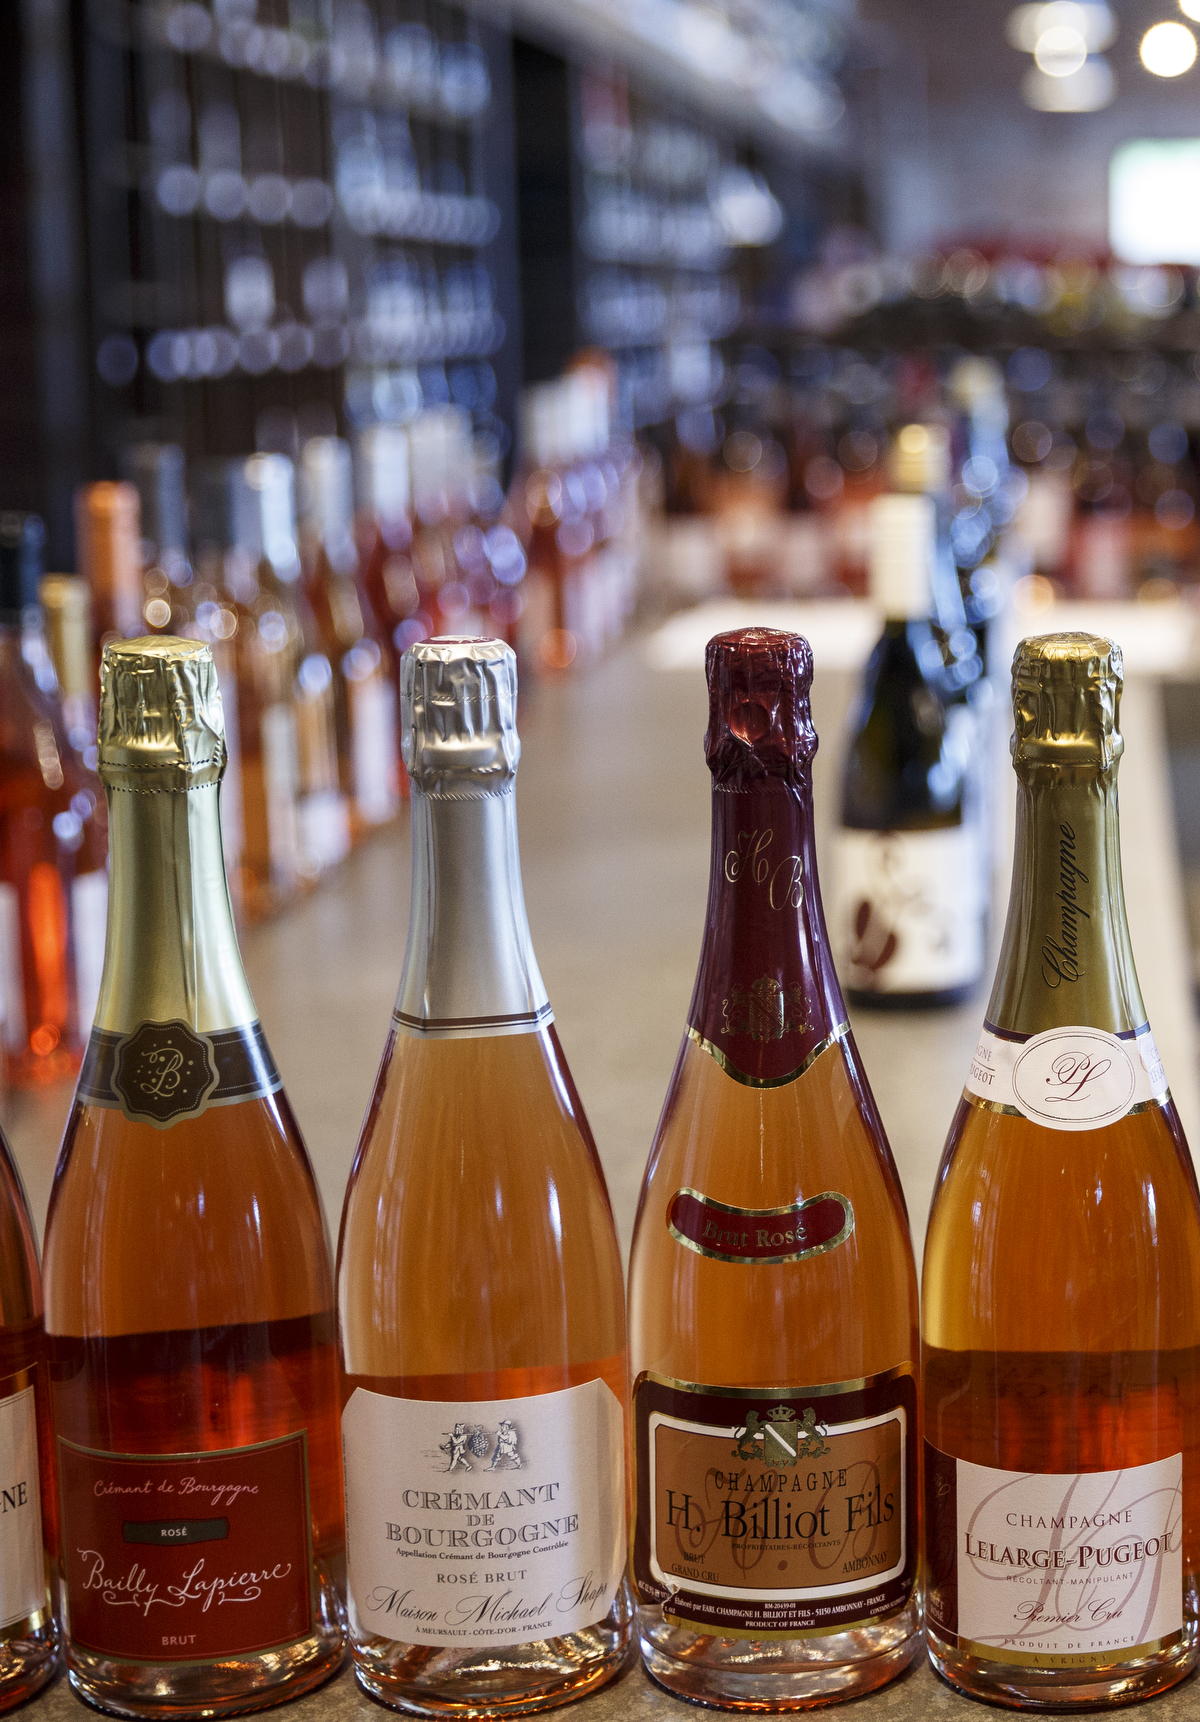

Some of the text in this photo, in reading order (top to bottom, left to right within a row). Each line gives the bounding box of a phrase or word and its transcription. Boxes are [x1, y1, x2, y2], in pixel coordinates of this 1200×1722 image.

[1041, 820, 1089, 989] Champagne
[703, 1220, 808, 1247] Brut Rosé
[94, 1477, 259, 1505] Crémant de Bourgogne
[714, 1468, 848, 1492] CHAMPAGNE
[401, 1482, 560, 1511] CRÉMANT
[466, 1514, 494, 1527] DE
[666, 1489, 701, 1533] H.
[721, 1497, 830, 1540] Billiot
[844, 1484, 895, 1534] Fils
[1006, 1509, 1133, 1529] CHAMPAGNE
[161, 1527, 188, 1537] ROSÉ
[385, 1513, 579, 1547] BOURGOGNE
[396, 1540, 569, 1560] Appellation Crémant de Bourgogne Contrôlée
[683, 1551, 706, 1566] BRUT
[964, 1531, 1173, 1570] LELARGE-PUGEOT
[671, 1562, 720, 1583] GRAND CRU
[842, 1550, 889, 1574] AMBONNAY
[77, 1548, 291, 1616] Bailly Lapierre
[437, 1570, 527, 1584] ROSÉ BRUT
[1006, 1572, 1134, 1585] RÉCOLTANT-MANIPULANT
[366, 1585, 438, 1622] Maison
[444, 1587, 554, 1626] Michael
[693, 1604, 702, 1612] par
[702, 1604, 716, 1613] EARL
[716, 1607, 753, 1618] CHAMPAGNE
[754, 1610, 762, 1618] H.
[763, 1609, 788, 1618] BILLIOT
[798, 1609, 811, 1617] FILS
[832, 1600, 864, 1615] AMBONNAY
[866, 1593, 886, 1606] FRANCE
[1014, 1597, 1123, 1623] Premier Cru
[421, 1627, 467, 1636] MEURSAULT
[473, 1627, 517, 1636] CÔTE-D'OR
[522, 1620, 553, 1631] FRANCE
[745, 1620, 778, 1629] PRODUCT
[789, 1619, 815, 1627] FRANCE
[161, 1634, 196, 1646] BRUT
[1003, 1635, 1135, 1649] PRODUIT DE FRANCE
[1033, 1653, 1108, 1665] À VRIGNY
